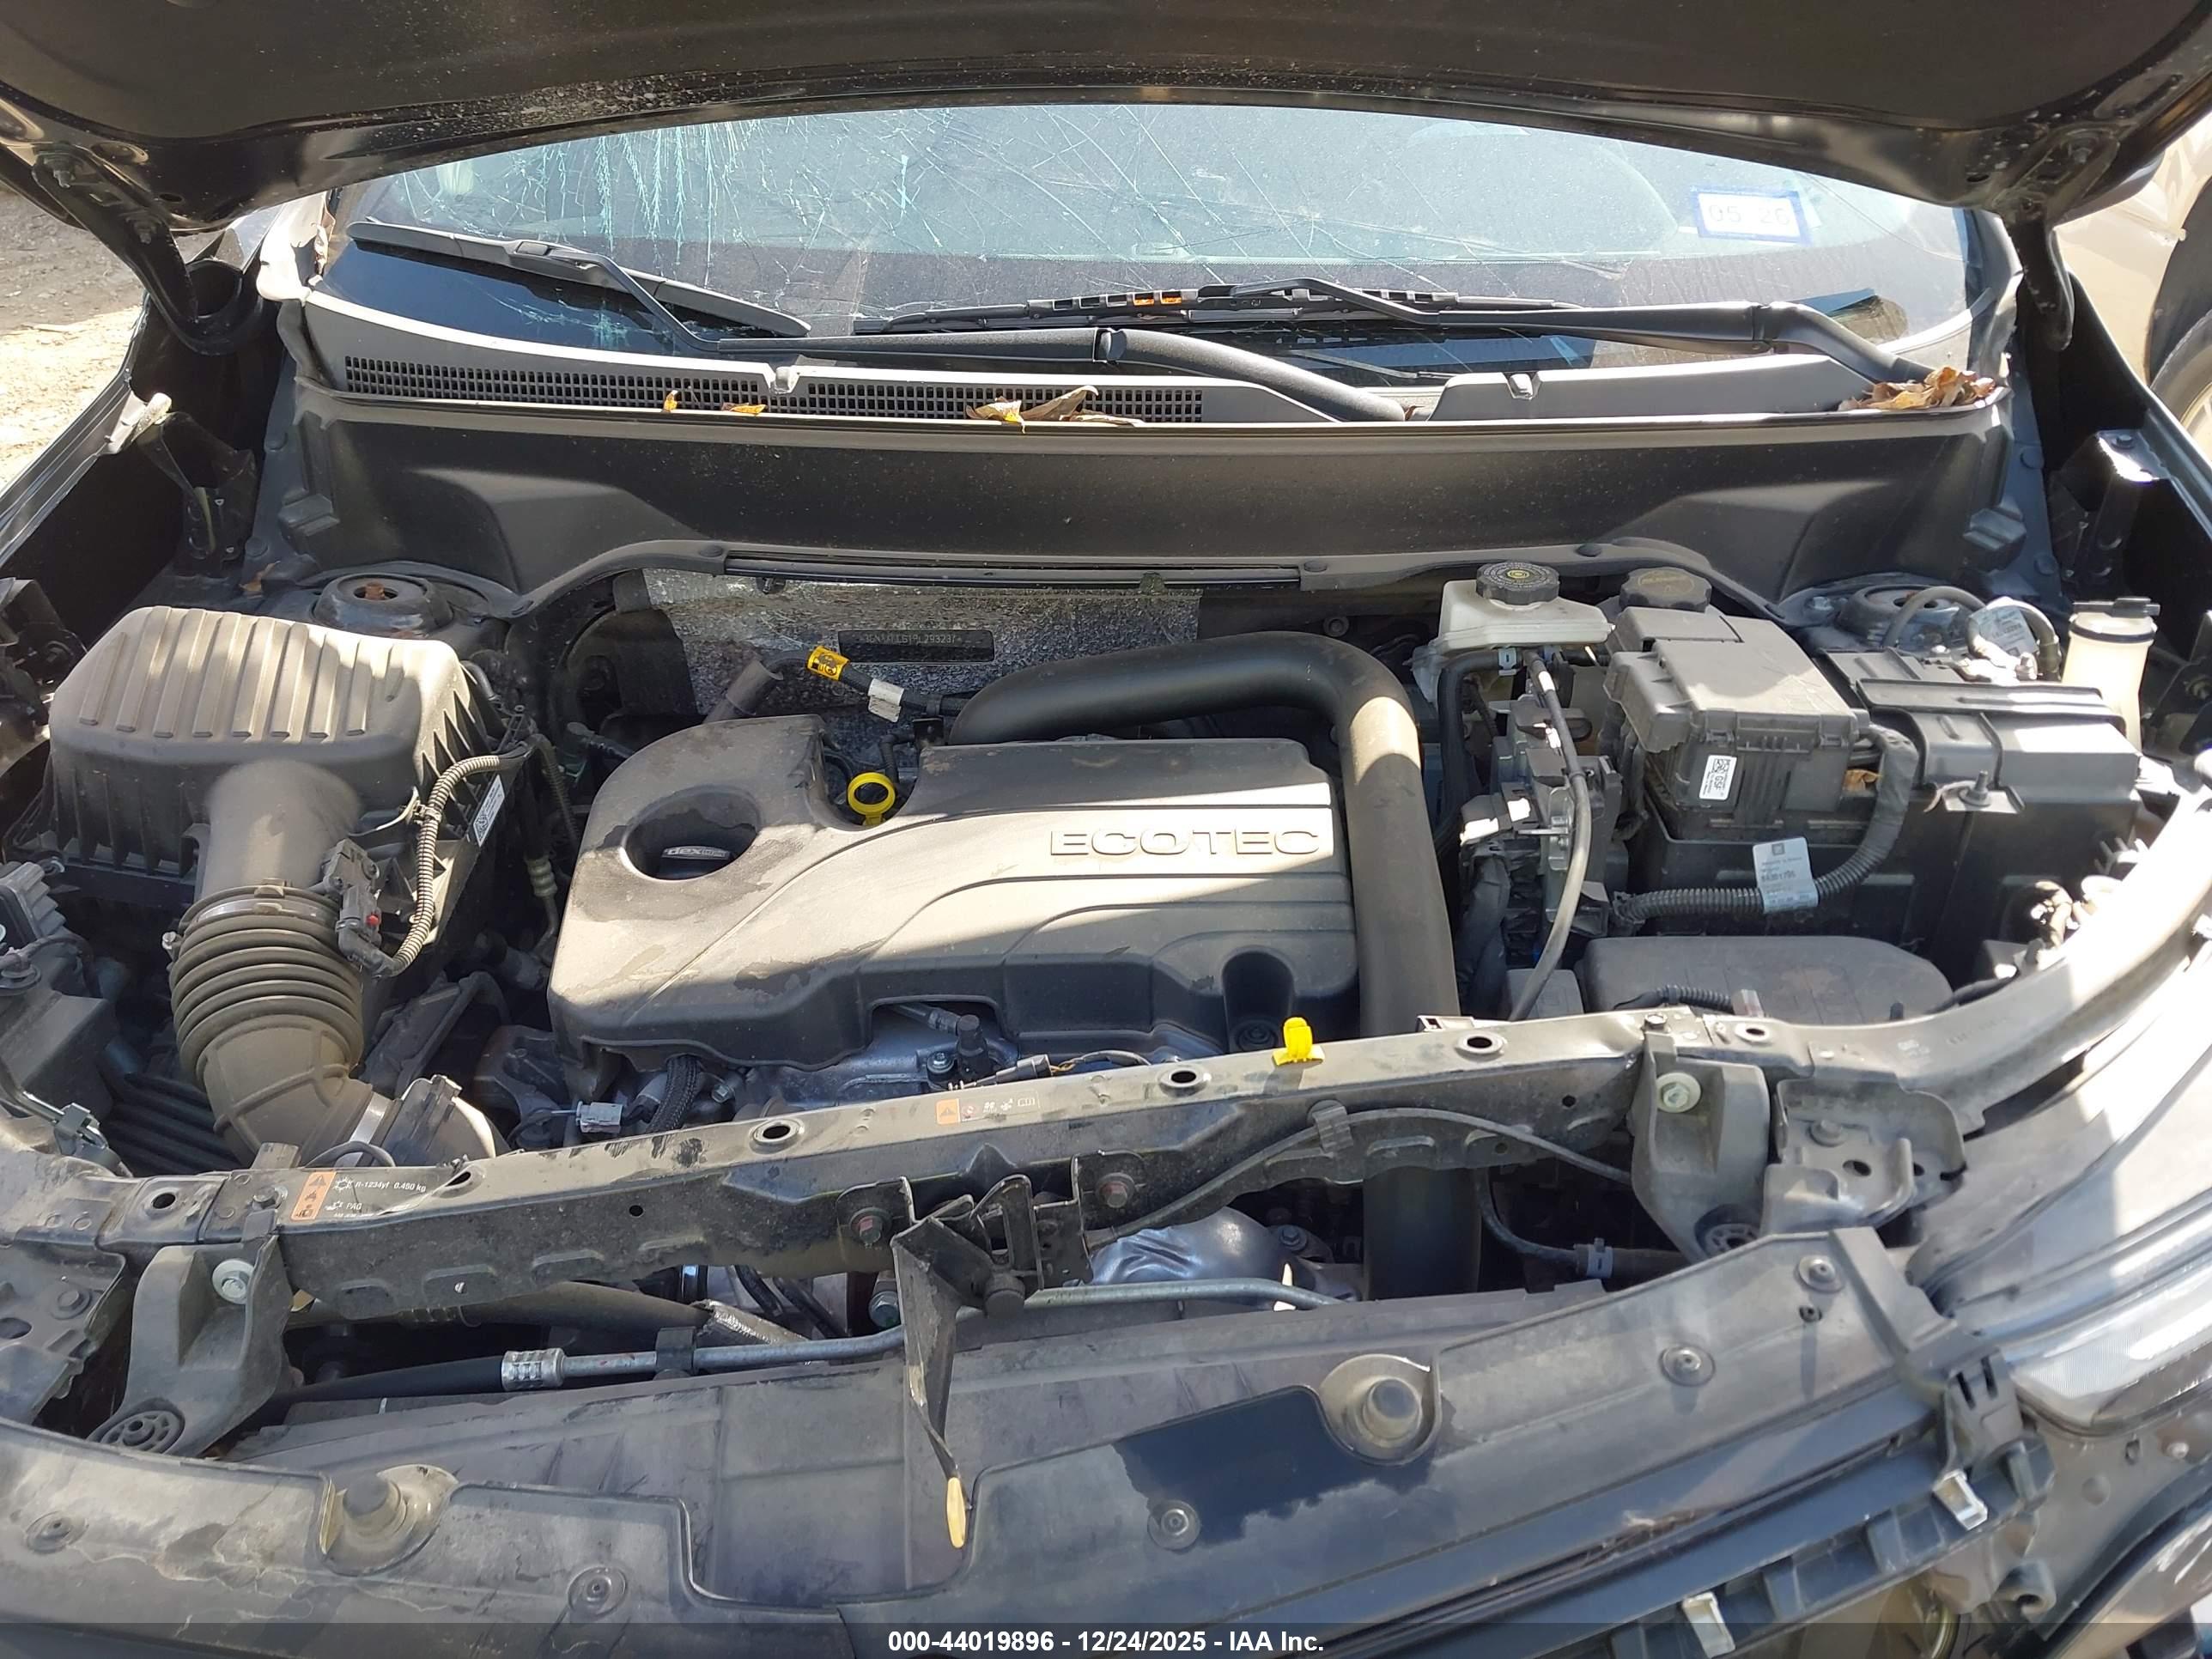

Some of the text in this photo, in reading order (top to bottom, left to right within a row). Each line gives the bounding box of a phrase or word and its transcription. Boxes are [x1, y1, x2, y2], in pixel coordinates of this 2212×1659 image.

[1708, 204, 1790, 226] 05 26
[1049, 828, 1320, 855] ECOTEC
[416, 1183, 427, 1193] kg
